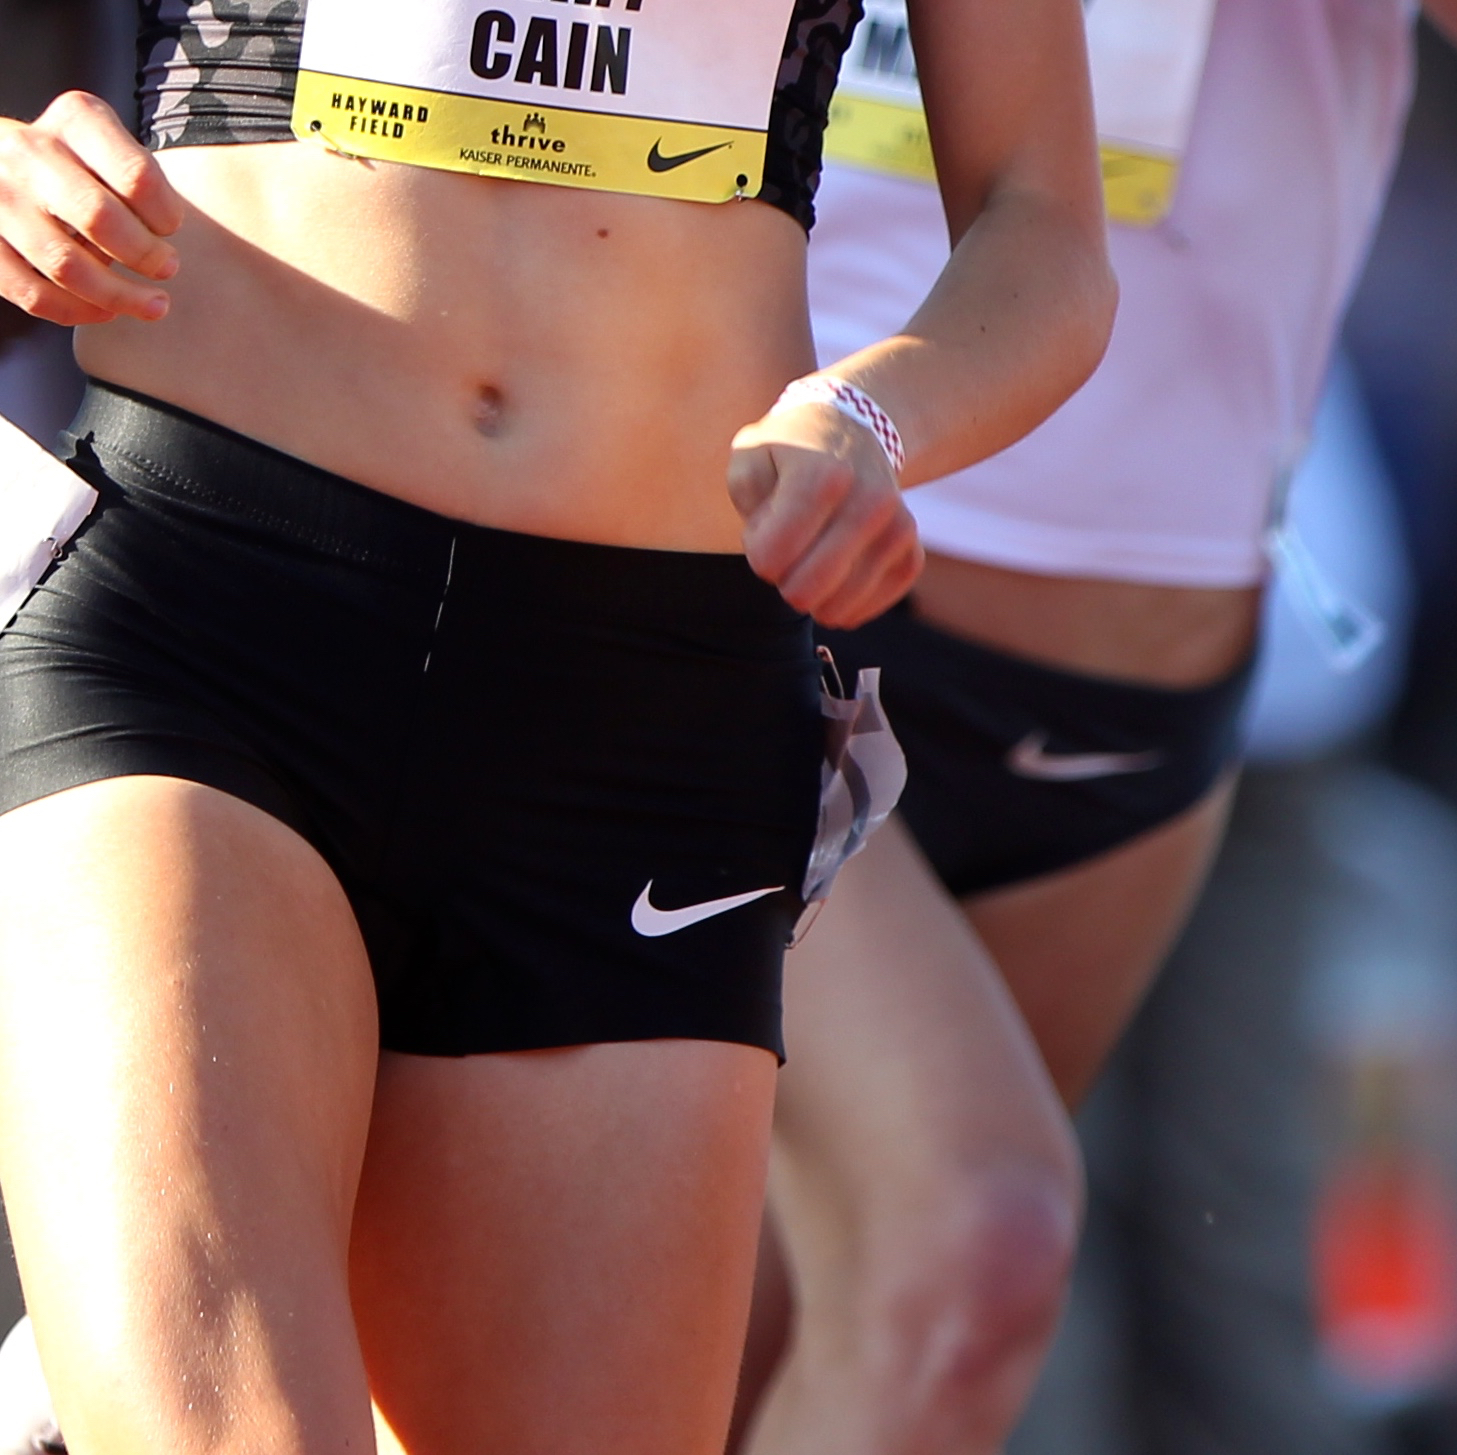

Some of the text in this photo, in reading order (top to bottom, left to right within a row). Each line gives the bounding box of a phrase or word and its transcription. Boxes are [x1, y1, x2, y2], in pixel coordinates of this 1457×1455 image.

[469, 9, 634, 96] CAIN
[331, 93, 429, 123] HAYWARD
[349, 116, 404, 139] FIELD
[490, 125, 566, 153] thrive
[459, 148, 502, 165] KAISER
